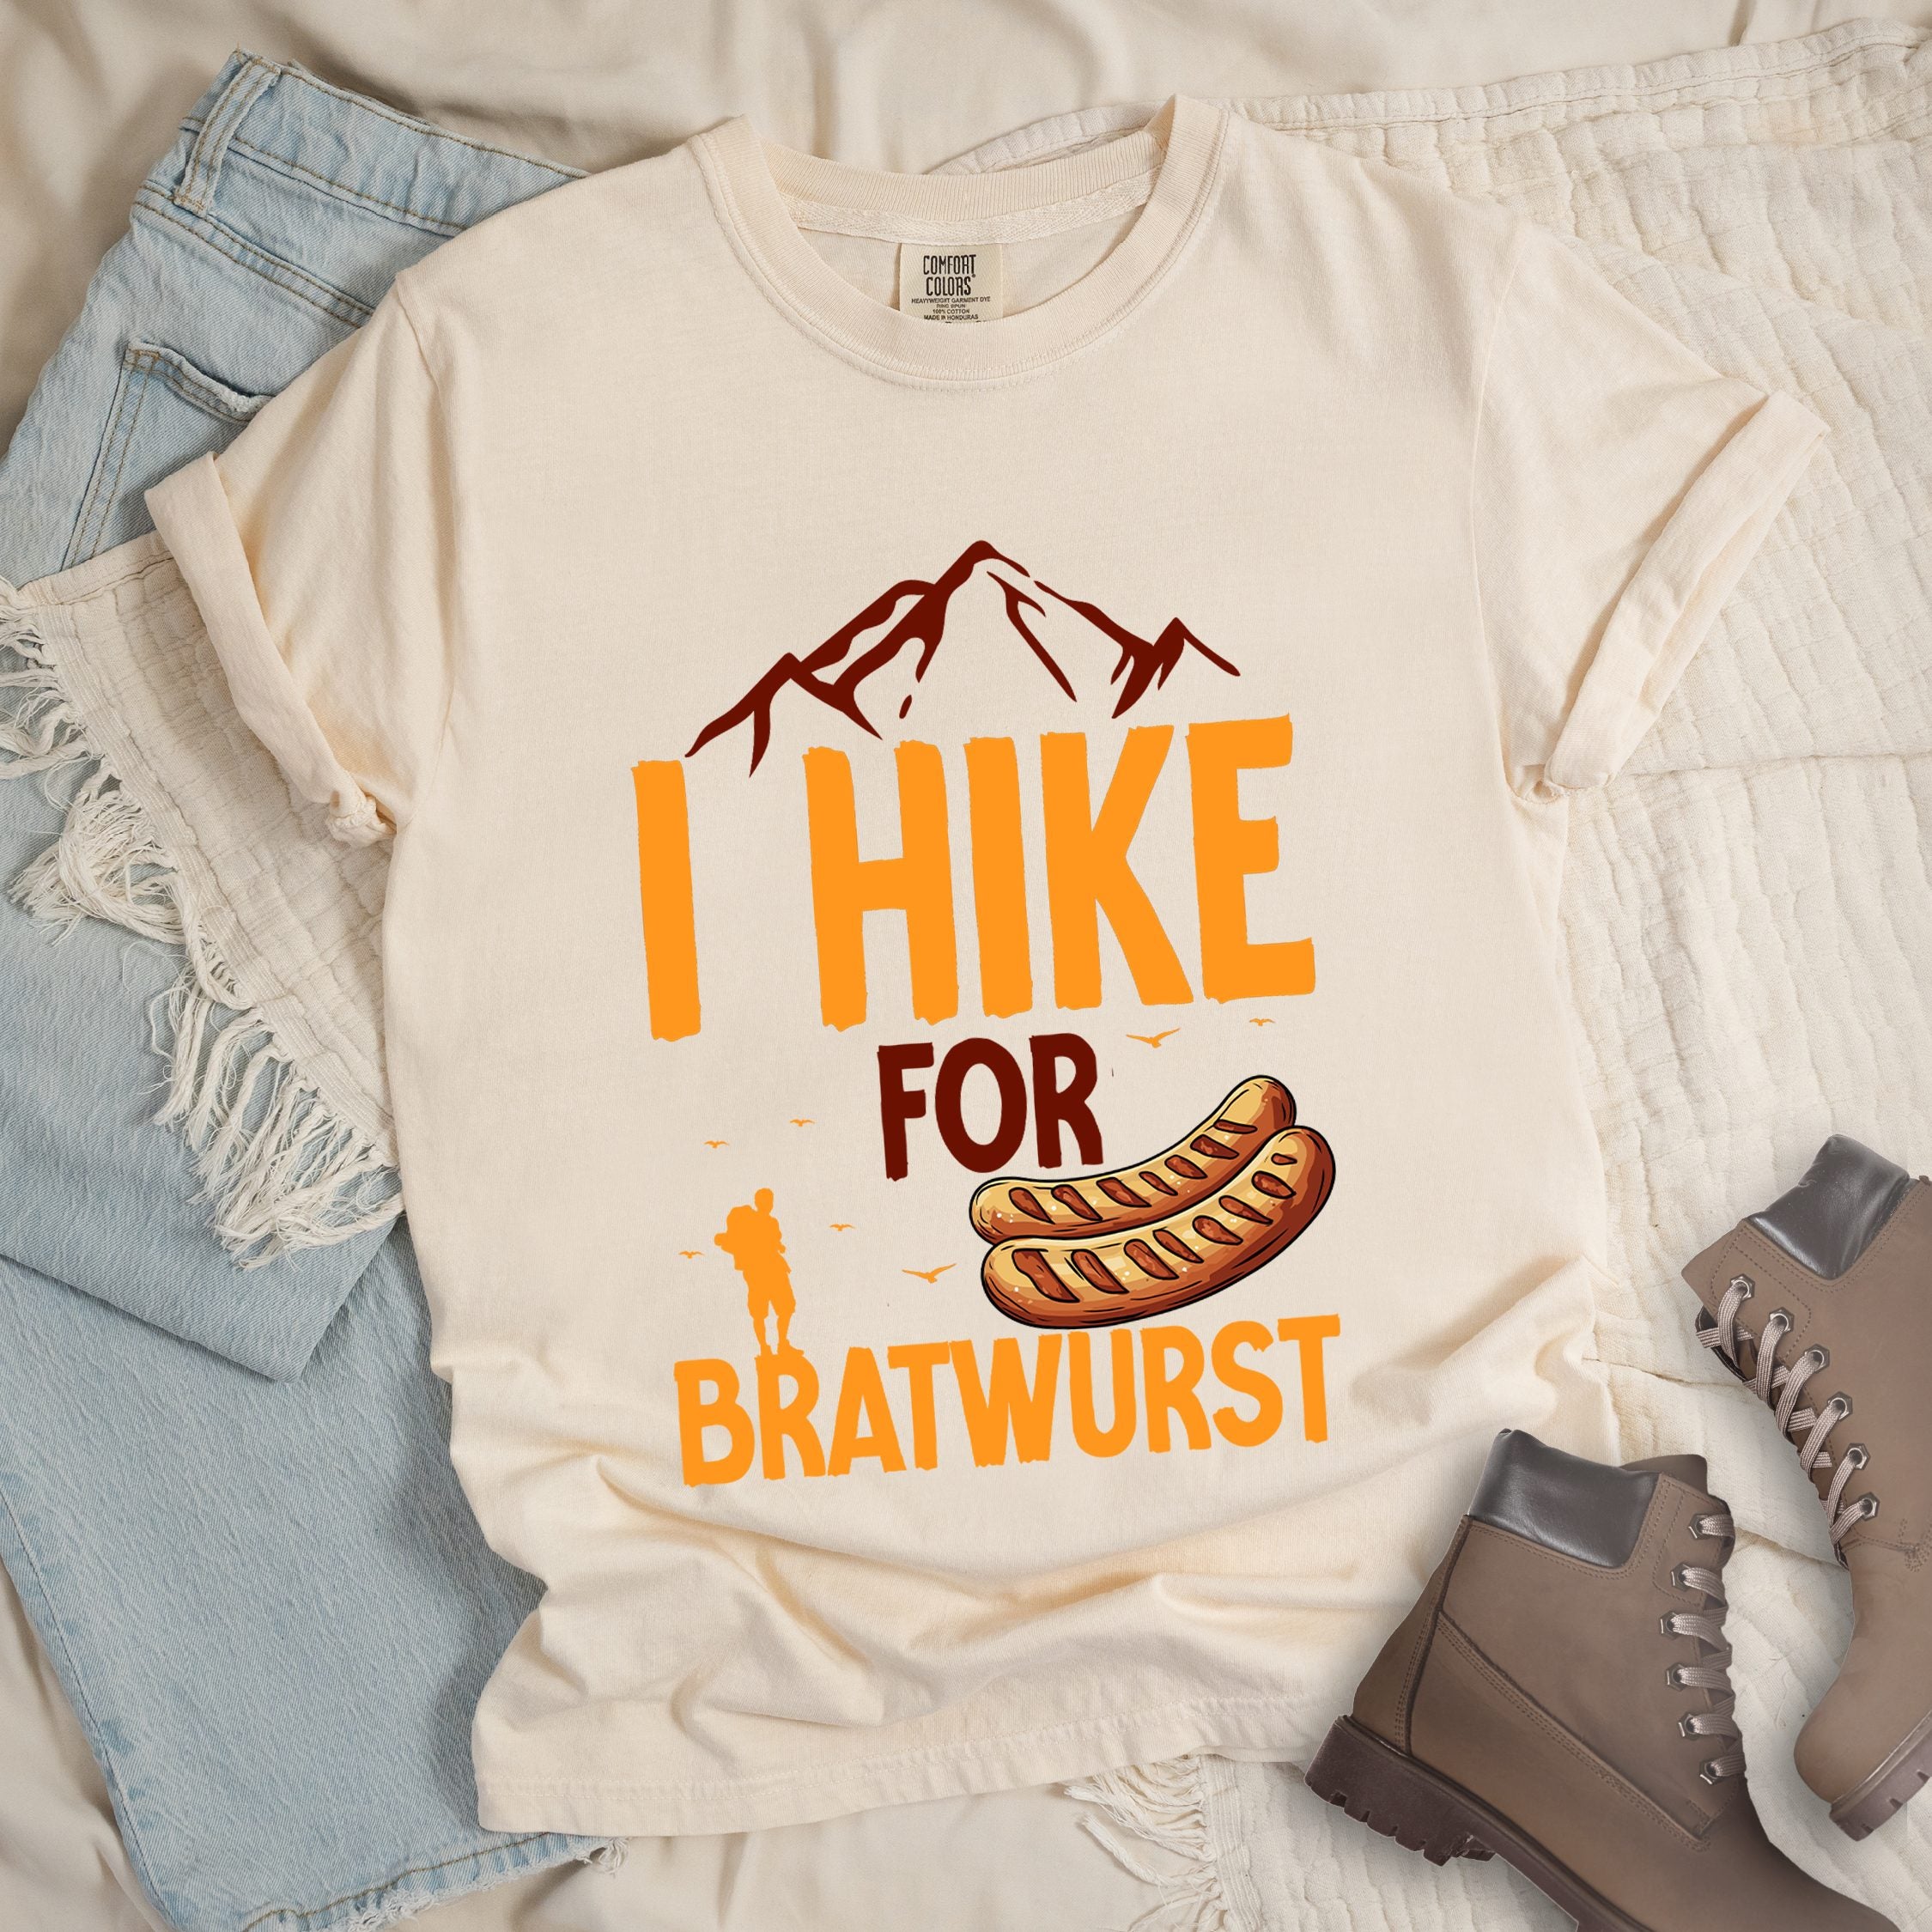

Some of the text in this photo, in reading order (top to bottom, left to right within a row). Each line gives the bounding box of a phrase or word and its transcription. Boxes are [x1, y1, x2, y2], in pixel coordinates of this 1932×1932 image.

[923, 254, 976, 275] COMFORT
[926, 276, 971, 296] COLORS
[633, 715, 1315, 1042] I HIKE
[878, 1033, 1103, 1182] FOR
[674, 1315, 1340, 1487] BRATWURST
